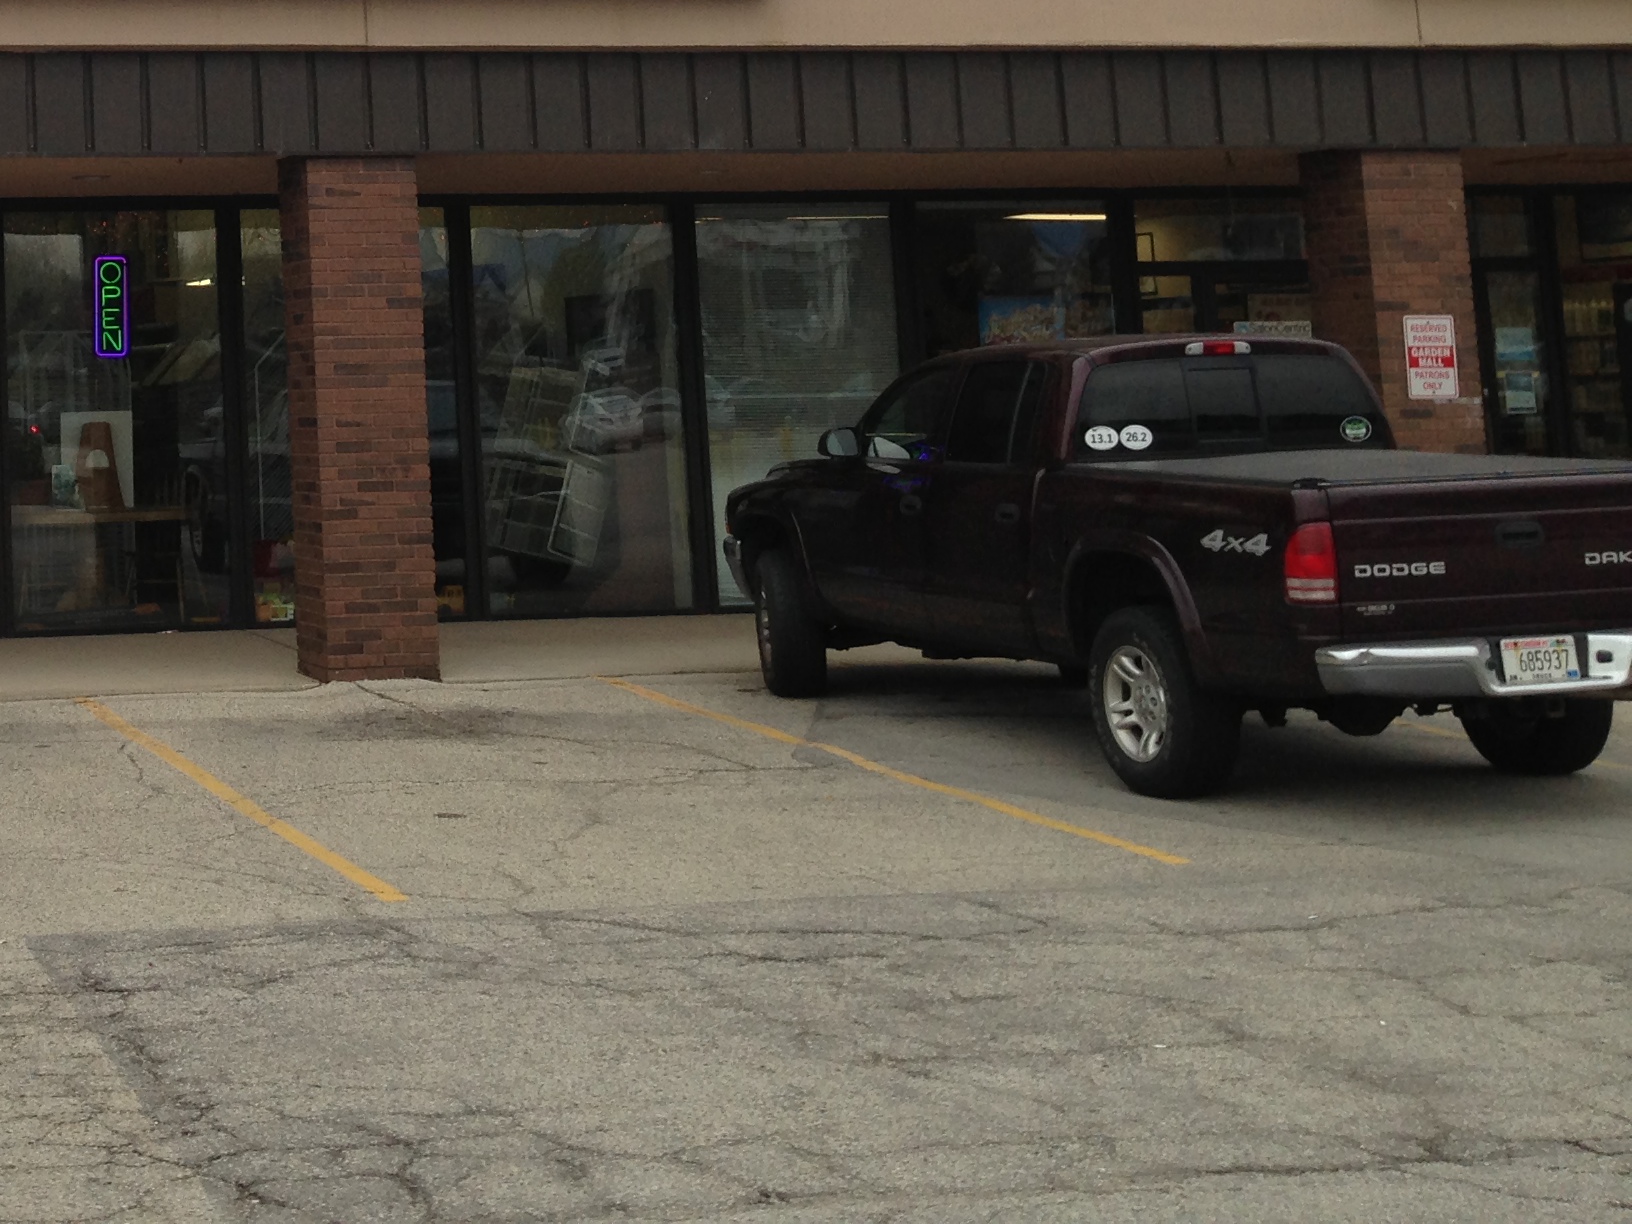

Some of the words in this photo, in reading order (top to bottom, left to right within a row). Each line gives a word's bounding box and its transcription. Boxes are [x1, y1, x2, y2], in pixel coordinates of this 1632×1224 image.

[100, 261, 122, 351] OPEN
[1411, 325, 1448, 333] RESERVED
[1411, 347, 1450, 357] GARDEN
[1418, 357, 1445, 367] MALL
[1415, 371, 1449, 379] PATRONS
[1423, 382, 1443, 390] ONLY
[1091, 433, 1114, 444] 13.1
[1125, 432, 1147, 442] 26.2
[1200, 529, 1272, 557] 4x4
[1354, 561, 1446, 577] DODGE
[1519, 648, 1569, 674] 685937
